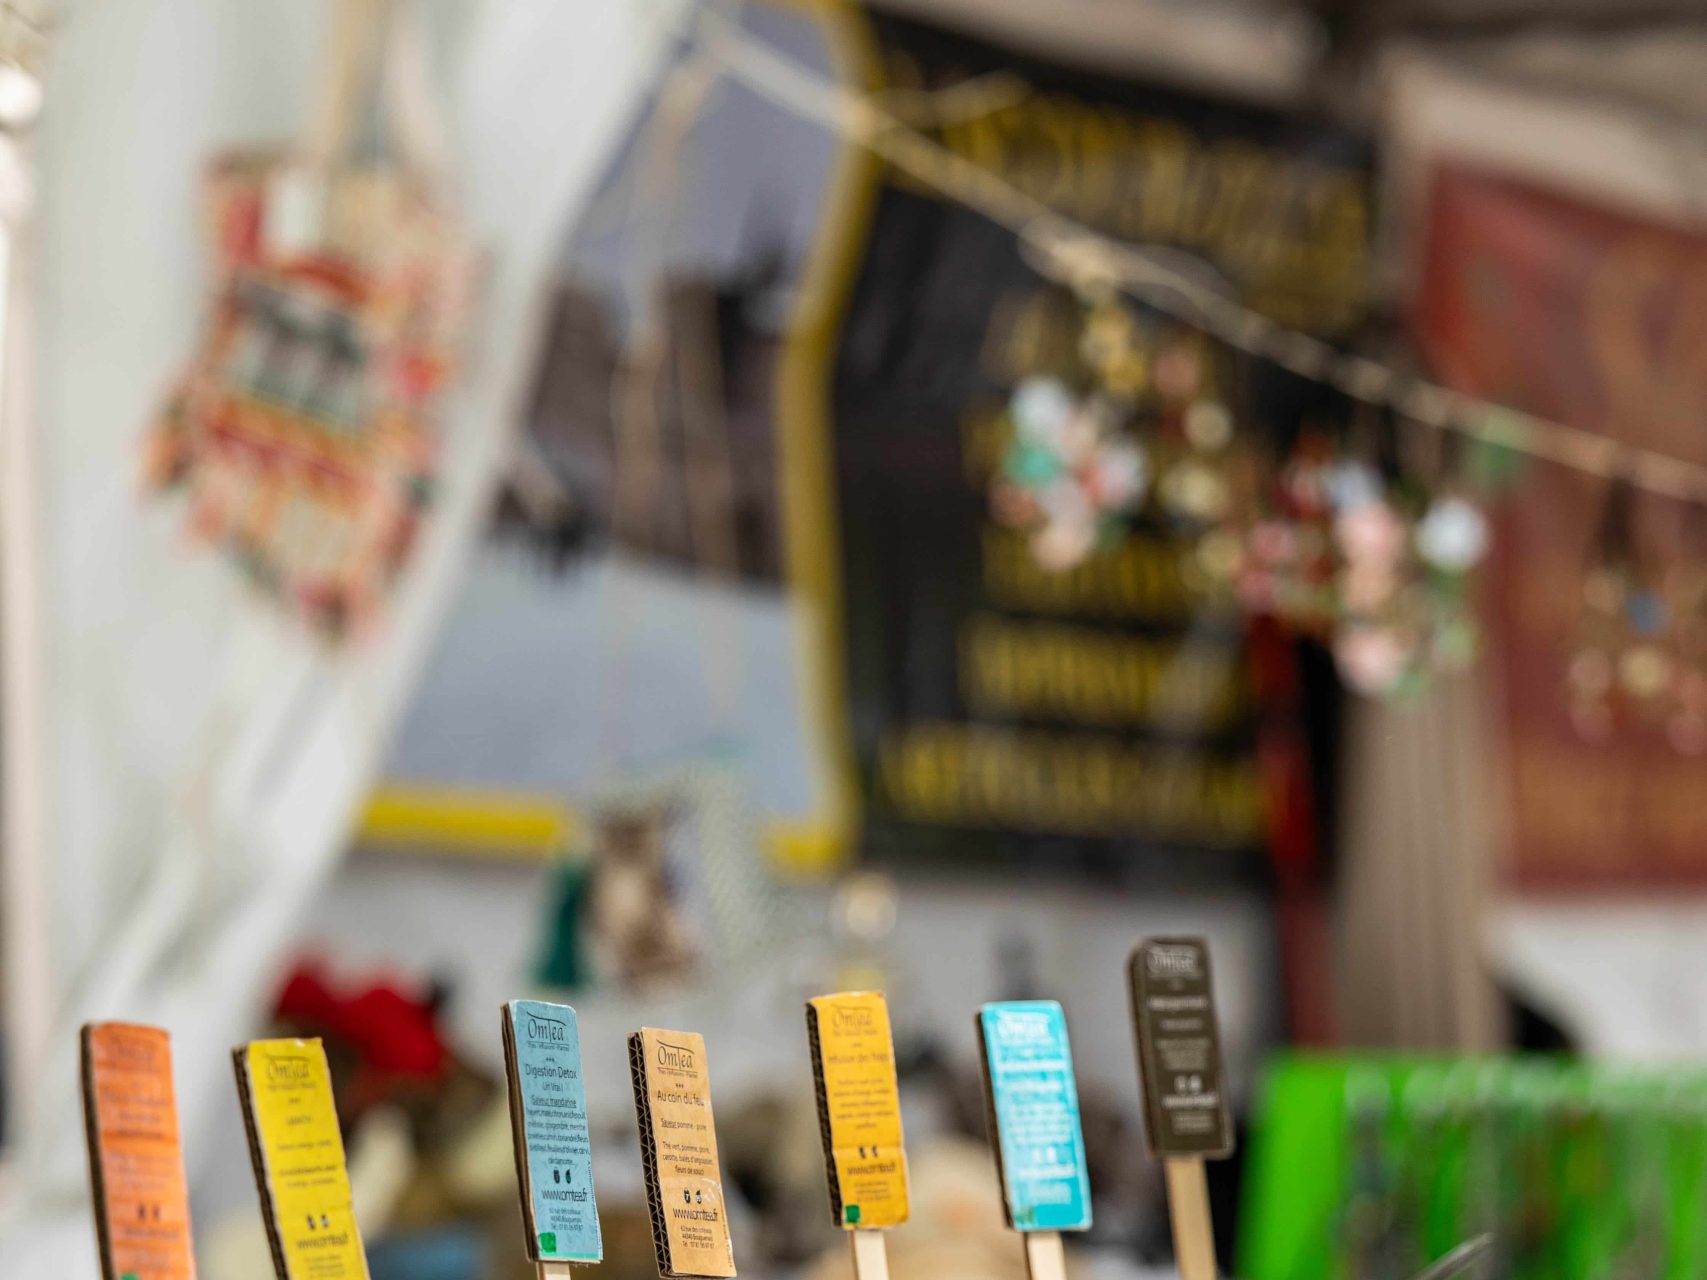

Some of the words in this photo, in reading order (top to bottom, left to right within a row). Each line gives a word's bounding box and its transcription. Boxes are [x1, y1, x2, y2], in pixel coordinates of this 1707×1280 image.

[527, 1011, 566, 1042] OmTea
[656, 1039, 695, 1071] OmTea
[525, 1064, 556, 1079] Digestion
[558, 1066, 577, 1079] Detox
[657, 1090, 666, 1101] Au
[668, 1092, 682, 1103] coin
[685, 1093, 693, 1104] du
